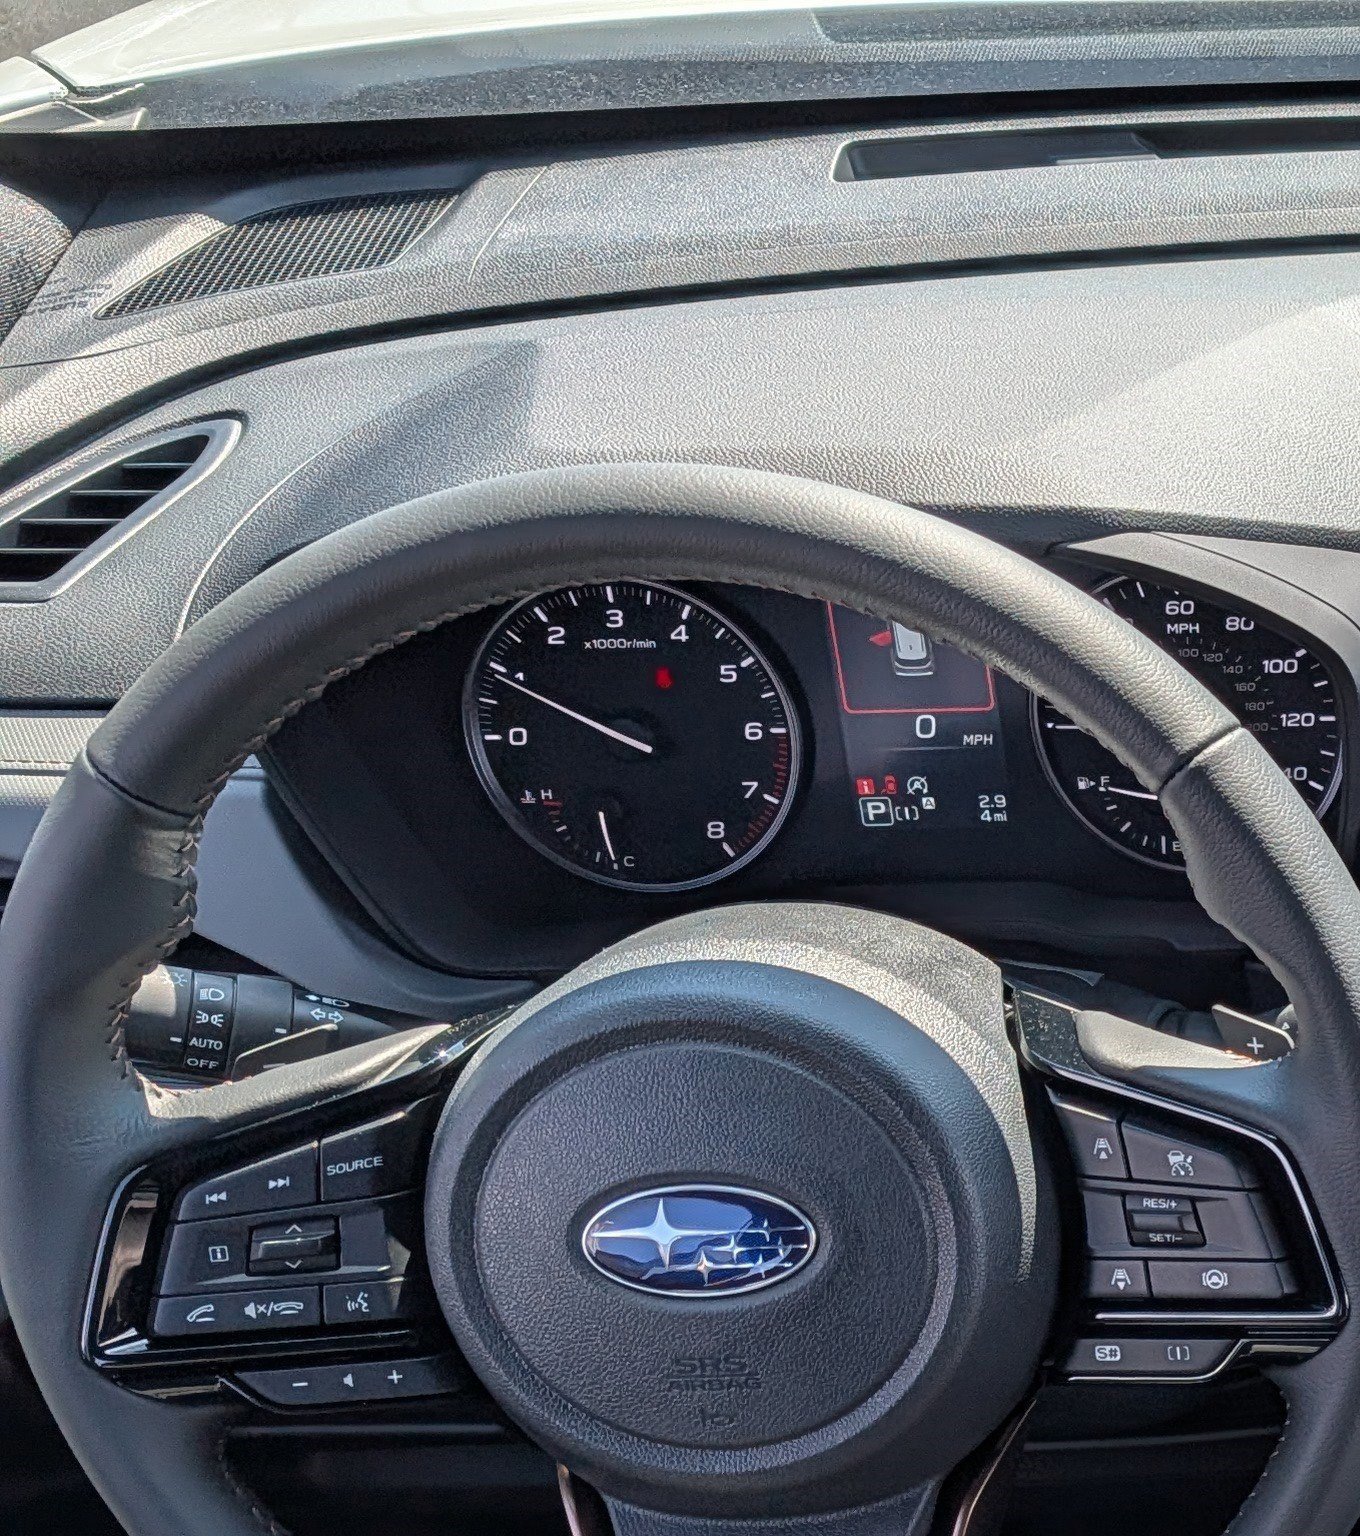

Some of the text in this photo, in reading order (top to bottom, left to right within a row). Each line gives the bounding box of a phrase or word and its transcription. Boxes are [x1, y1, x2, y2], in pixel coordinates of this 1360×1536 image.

[1165, 601, 1195, 615] 60
[606, 610, 624, 627] 3
[1225, 617, 1254, 631] 80
[670, 625, 689, 643] 4
[1167, 623, 1200, 634] MPH
[547, 627, 566, 645] 2
[584, 638, 656, 649] x1000r/min
[1203, 653, 1223, 662] 120
[1223, 666, 1243, 674] 140
[1262, 659, 1298, 673] 100
[719, 665, 738, 683] 5
[1235, 683, 1255, 691] 160
[915, 714, 936, 738] 0
[1280, 713, 1315, 727] 120
[508, 727, 527, 746] 0
[744, 722, 763, 741] 6
[963, 734, 993, 746] MPH
[1100, 776, 1109, 786] F
[541, 790, 552, 800] H
[741, 782, 759, 798] 7
[978, 794, 1007, 808] 2.9
[867, 802, 885, 821] P
[707, 821, 725, 839] 8
[623, 856, 635, 867] C
[189, 1037, 223, 1050] AUTO
[187, 1058, 219, 1069] OFF
[326, 1156, 384, 1176] SOURCE
[1143, 1198, 1177, 1209] RES/+
